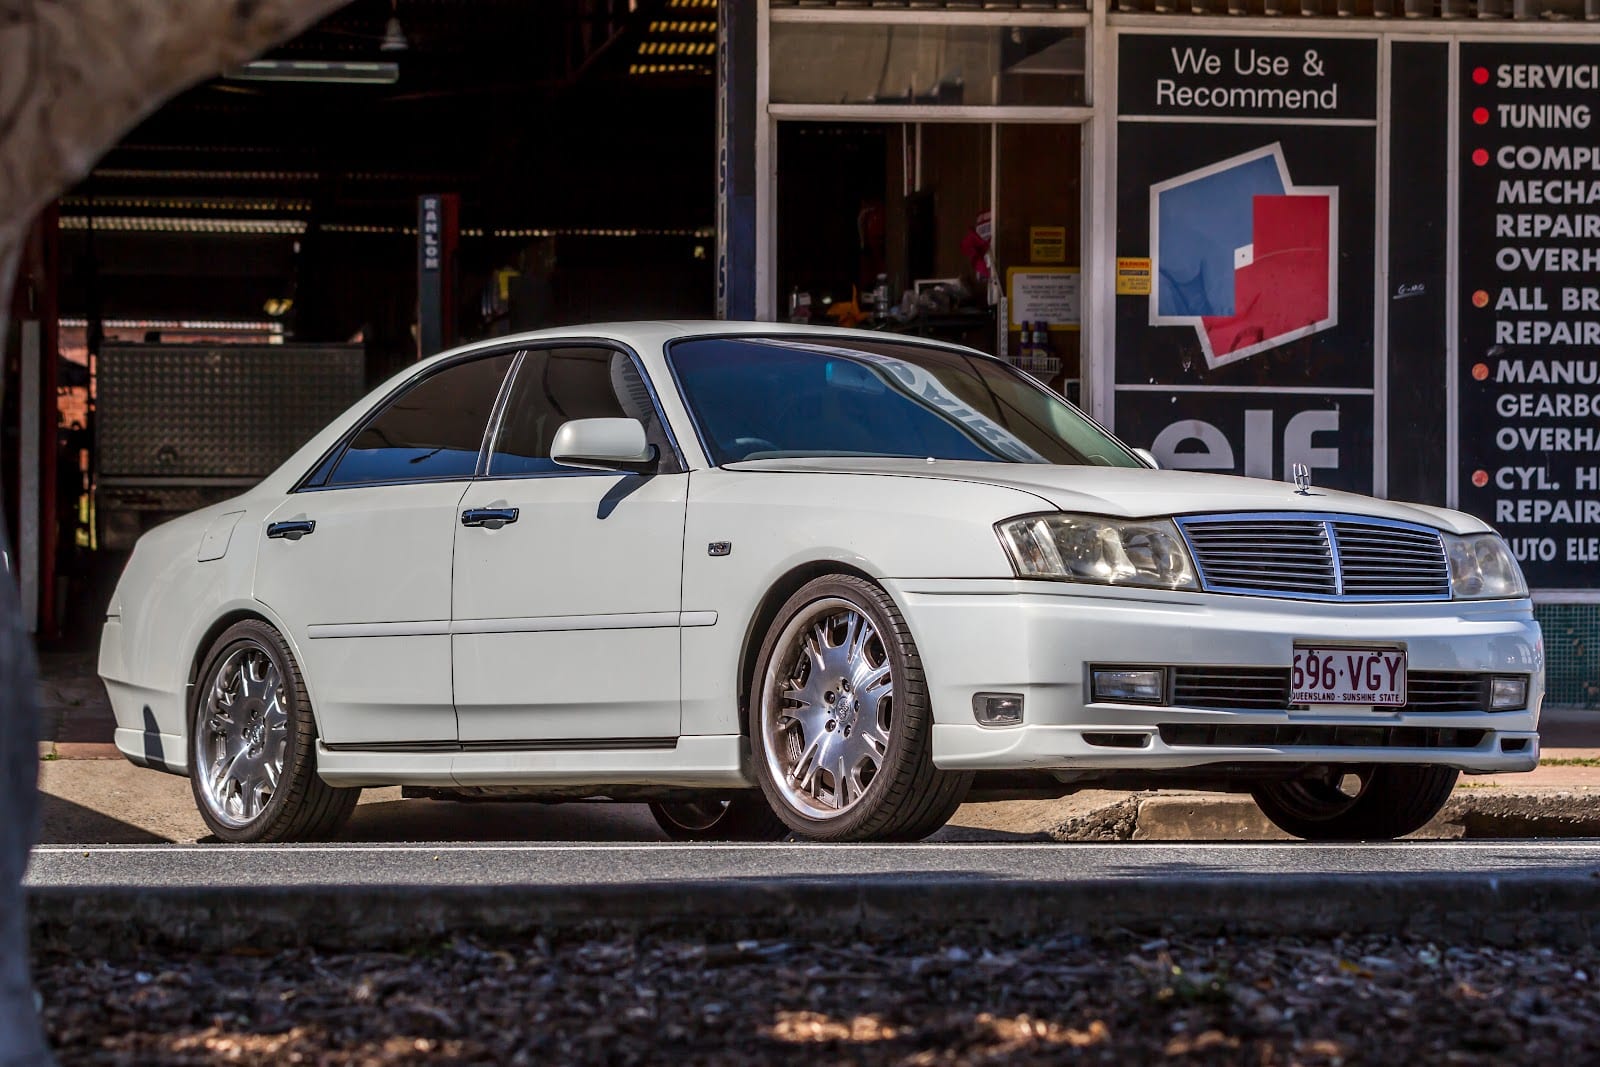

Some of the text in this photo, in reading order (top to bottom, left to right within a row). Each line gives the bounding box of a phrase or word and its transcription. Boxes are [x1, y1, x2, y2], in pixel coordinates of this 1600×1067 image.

[1172, 48, 1324, 76] We Use &
[1497, 65, 1598, 88] SERVICI
[1157, 80, 1336, 108] Recommend
[1498, 105, 1590, 128] TUNING
[1497, 214, 1600, 237] REPAIR
[1496, 248, 1600, 271] OVERH
[1495, 288, 1600, 310] ALL BR
[1496, 321, 1600, 344] REPAIR
[1496, 360, 1600, 384] MANU
[1150, 409, 1339, 487] elf
[1496, 428, 1600, 451] OVERH
[1496, 467, 1600, 490] CYL. H
[1497, 500, 1600, 523] REPAIR
[1567, 538, 1600, 560] ELE
[1342, 693, 1376, 702] SUNSHINE
[1379, 693, 1399, 702] STATE
